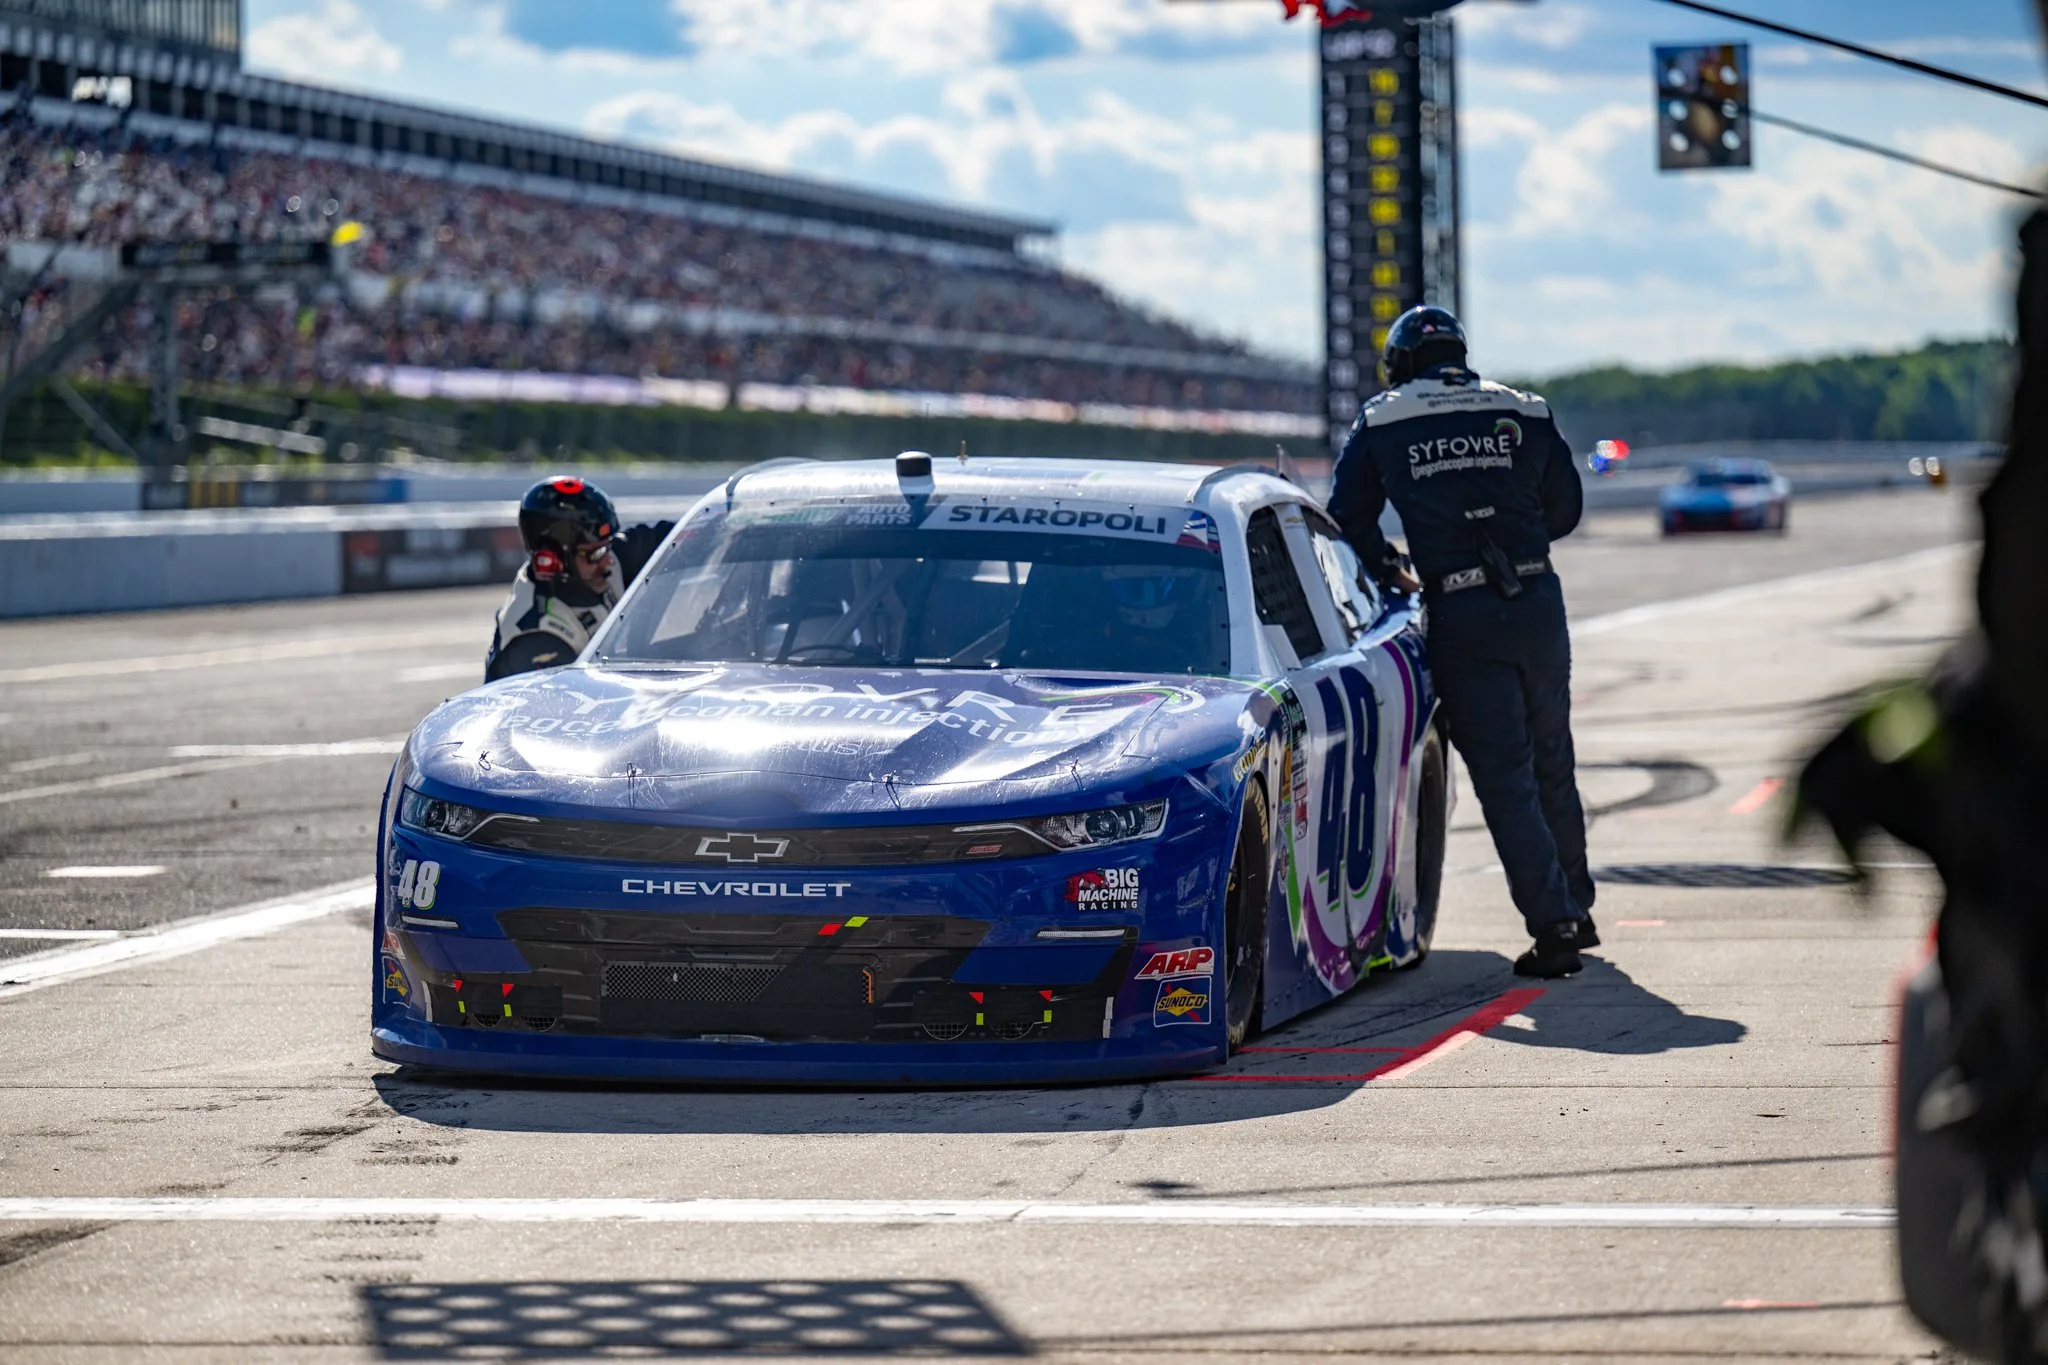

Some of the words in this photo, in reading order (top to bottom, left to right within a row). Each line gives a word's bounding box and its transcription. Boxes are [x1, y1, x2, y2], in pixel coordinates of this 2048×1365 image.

[1408, 434, 1511, 464] SYFOVRE
[856, 503, 911, 514] AUTO
[845, 513, 912, 525] PARTS
[948, 504, 1166, 535] STAROPOLI
[397, 859, 441, 910] 48
[1104, 867, 1140, 888] BIG
[621, 879, 852, 897] CHEVROLET
[1078, 887, 1139, 902] MACHINE
[1078, 901, 1138, 911] RACING
[1140, 948, 1213, 975] ARP
[1158, 995, 1205, 1009] SUNOCO
